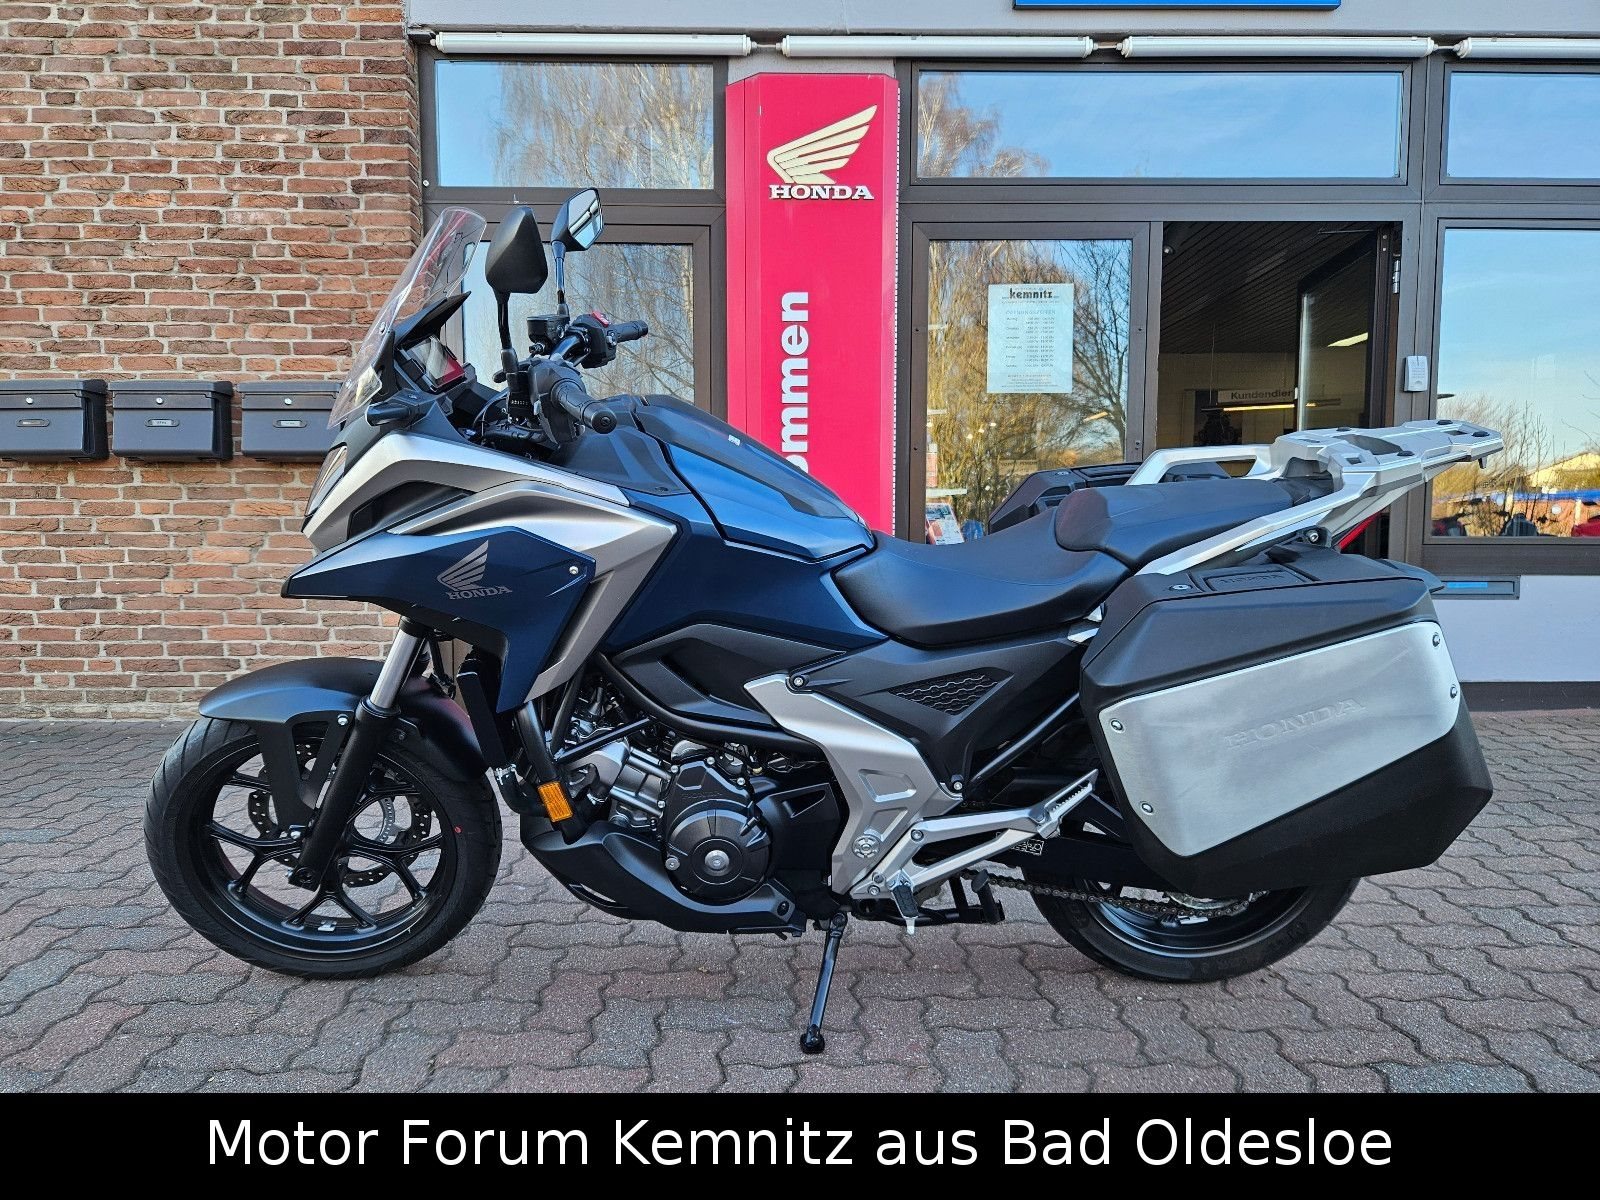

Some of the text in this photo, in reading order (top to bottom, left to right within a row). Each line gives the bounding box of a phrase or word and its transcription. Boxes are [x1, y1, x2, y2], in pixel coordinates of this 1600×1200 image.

[769, 184, 875, 200] HONDA
[1009, 287, 1053, 299] kemnitz
[446, 585, 513, 600] HONDA
[1223, 698, 1367, 750] HONDA
